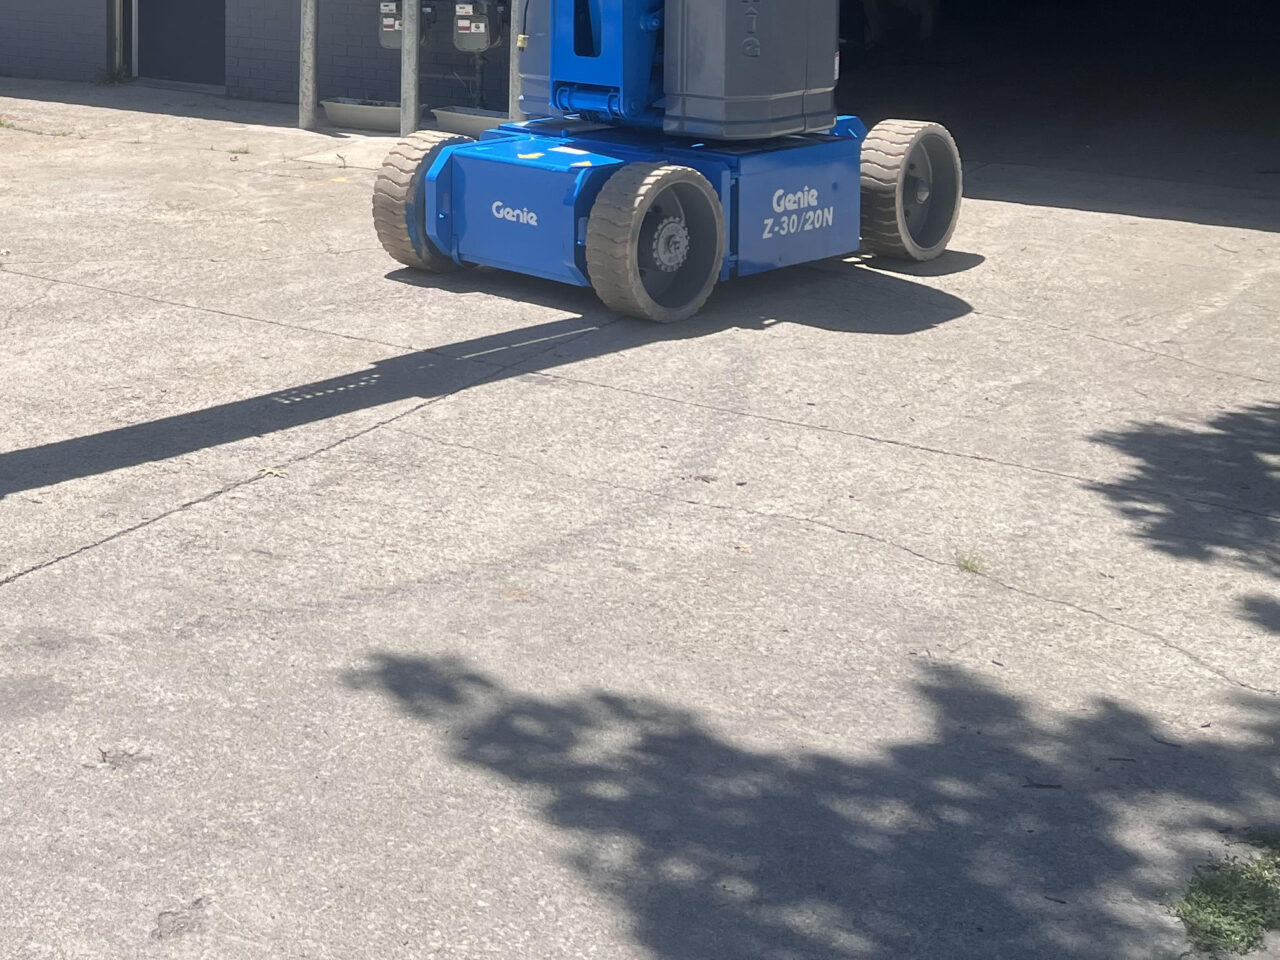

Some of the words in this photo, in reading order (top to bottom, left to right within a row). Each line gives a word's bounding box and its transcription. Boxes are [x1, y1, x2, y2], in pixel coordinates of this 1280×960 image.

[491, 200, 538, 226] Genie
[772, 185, 818, 213] Genie
[762, 206, 834, 239] Z-30/20N
